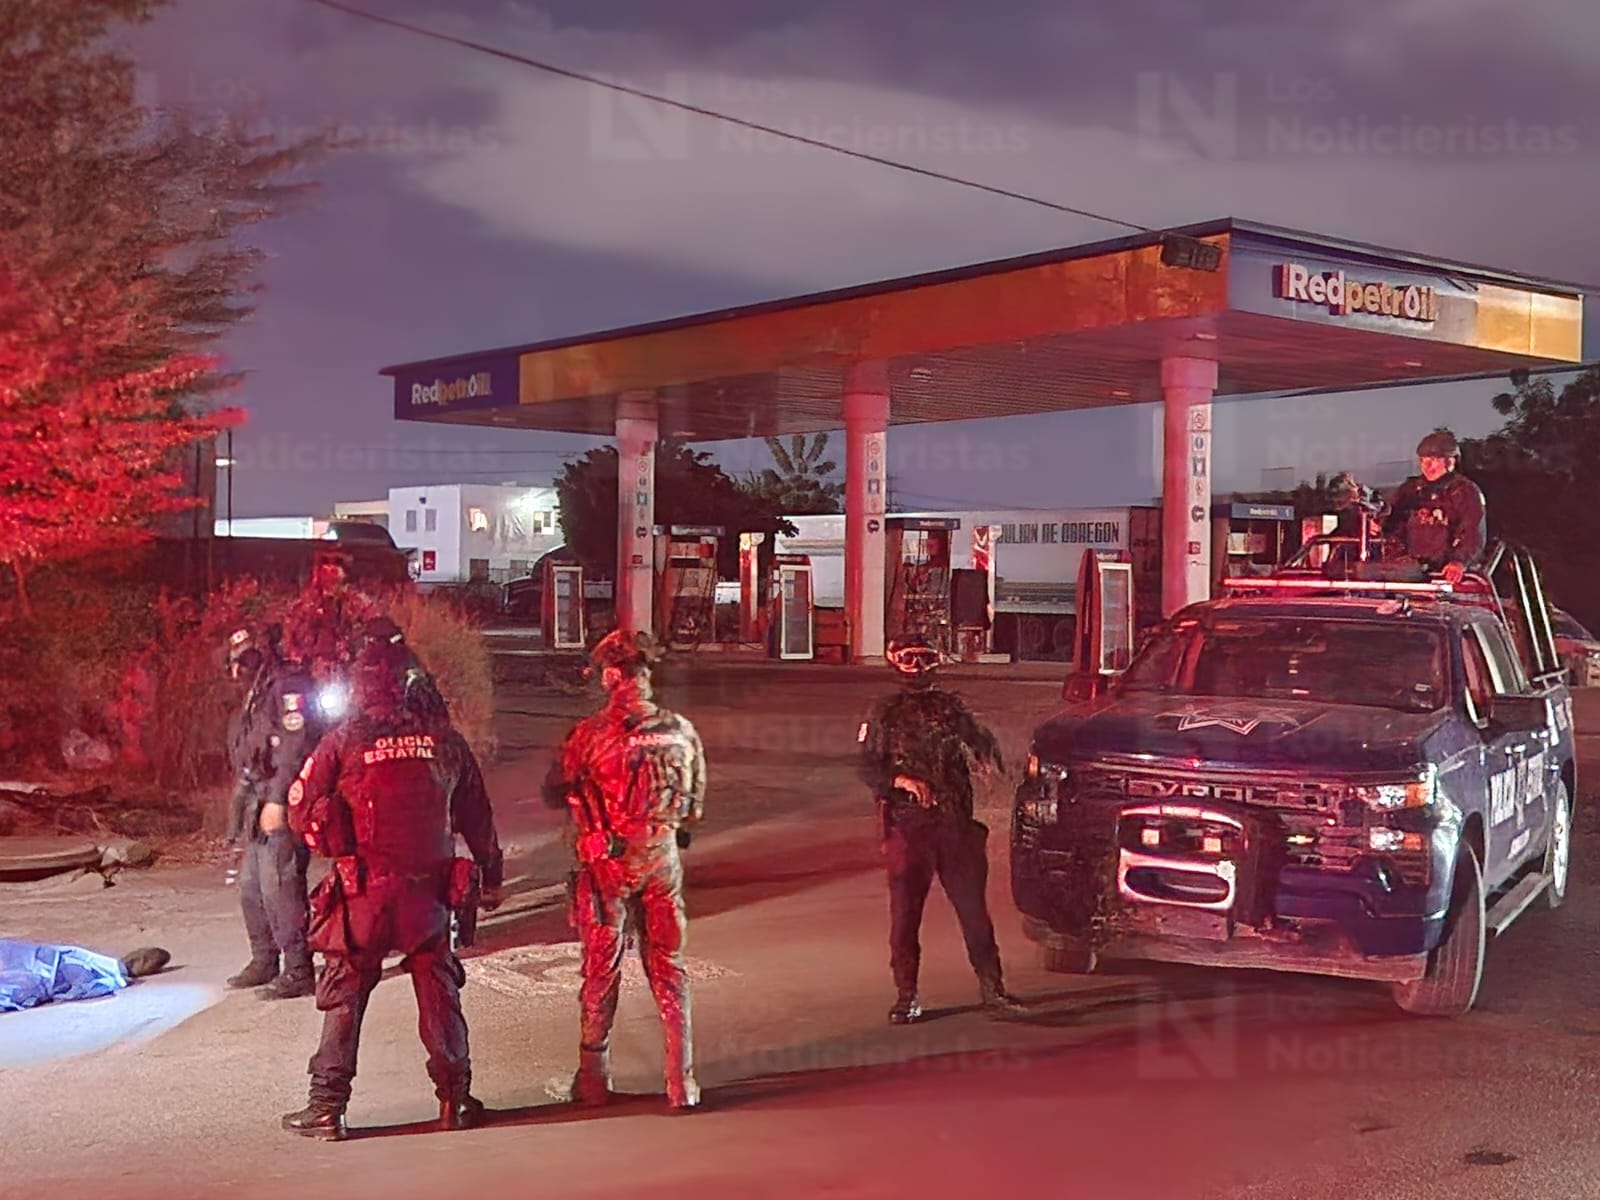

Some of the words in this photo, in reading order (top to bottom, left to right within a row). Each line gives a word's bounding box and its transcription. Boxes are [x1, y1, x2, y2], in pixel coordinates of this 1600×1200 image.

[1042, 523, 1058, 544] DE
[1061, 522, 1119, 544] OBREGON
[374, 735, 434, 749] OLICIA
[364, 747, 434, 765] ESTATAL
